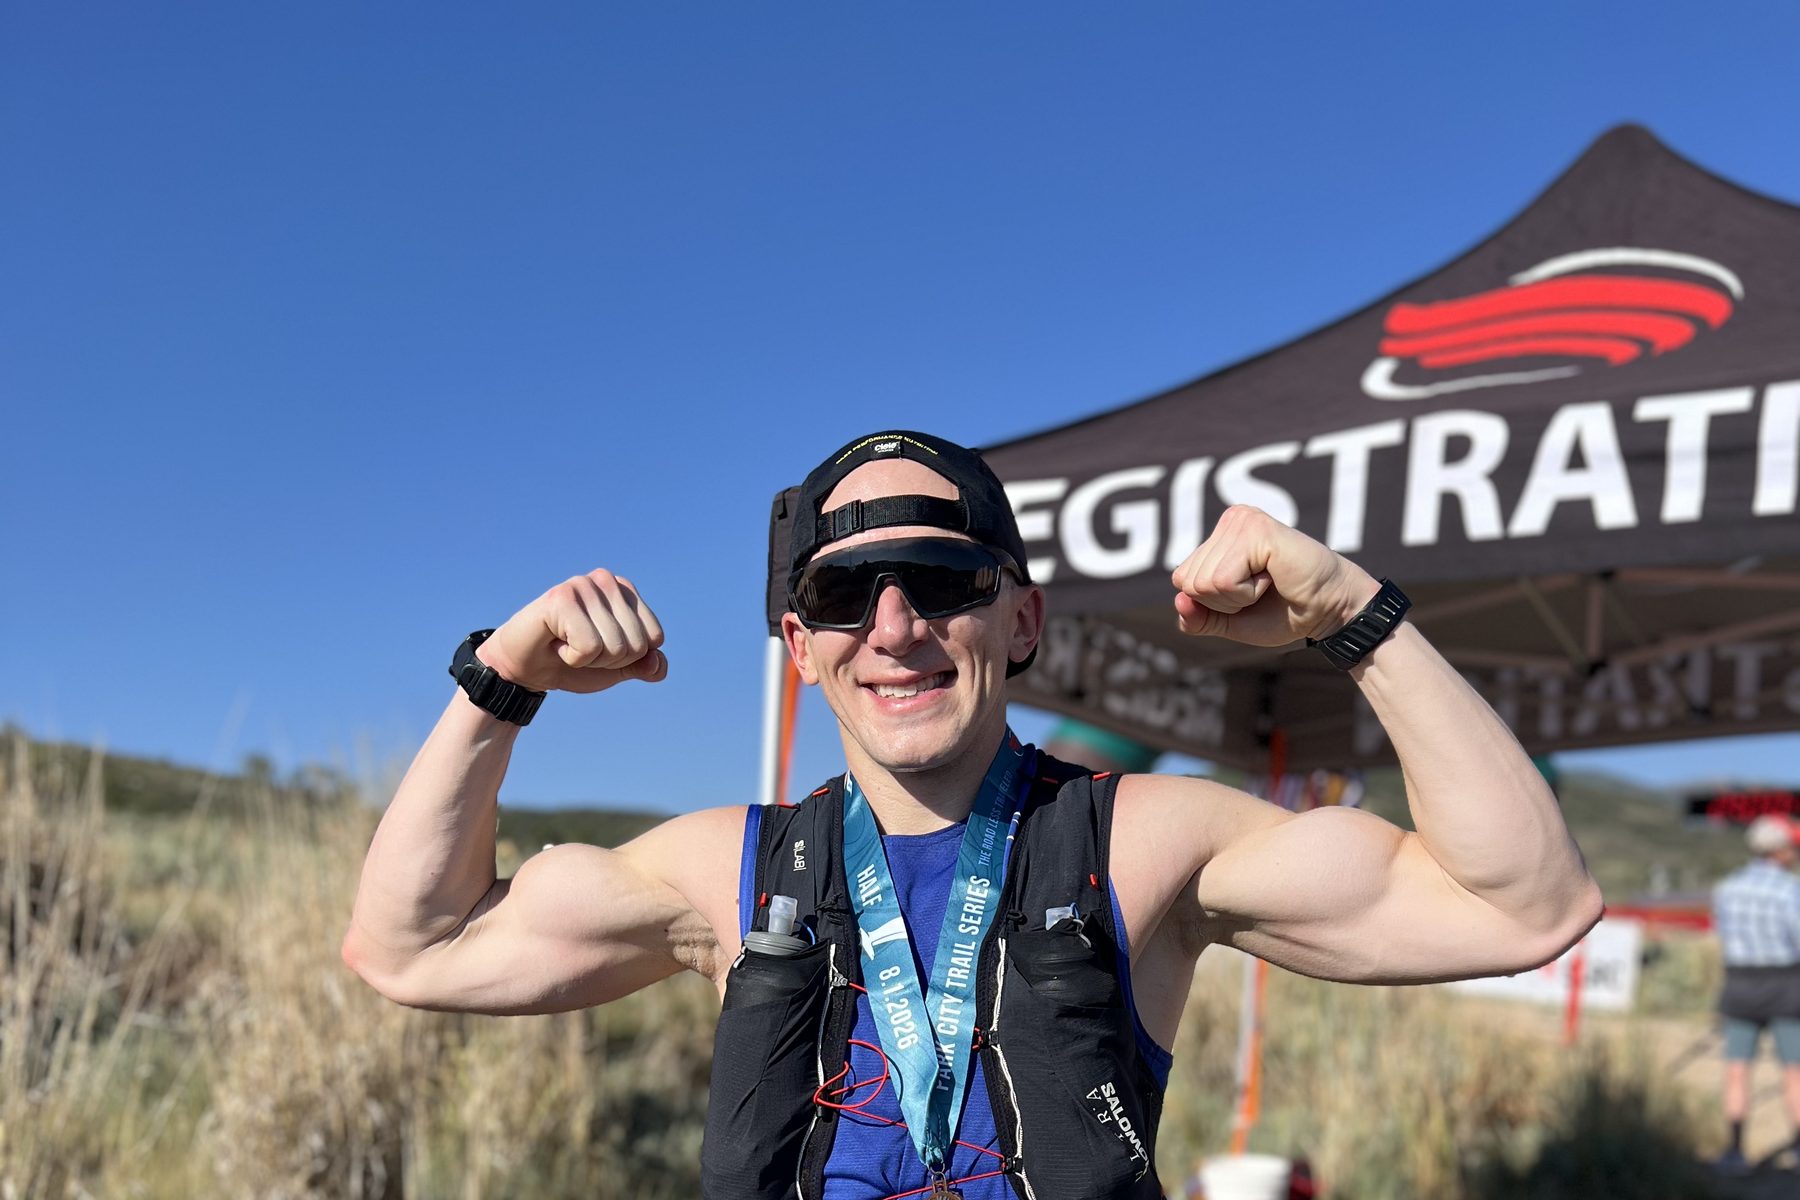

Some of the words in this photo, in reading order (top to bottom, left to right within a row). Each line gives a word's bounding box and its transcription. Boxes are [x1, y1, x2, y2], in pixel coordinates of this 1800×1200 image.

[982, 827, 995, 849] ROAD
[988, 807, 1002, 829] LESS
[978, 848, 991, 866] THE
[856, 864, 883, 906] HALF
[958, 875, 991, 935] SERIES
[946, 941, 976, 989] TRAIL
[878, 965, 919, 1050] 8.1.2026
[937, 993, 963, 1036] CITY
[935, 1040, 956, 1091] PARK
